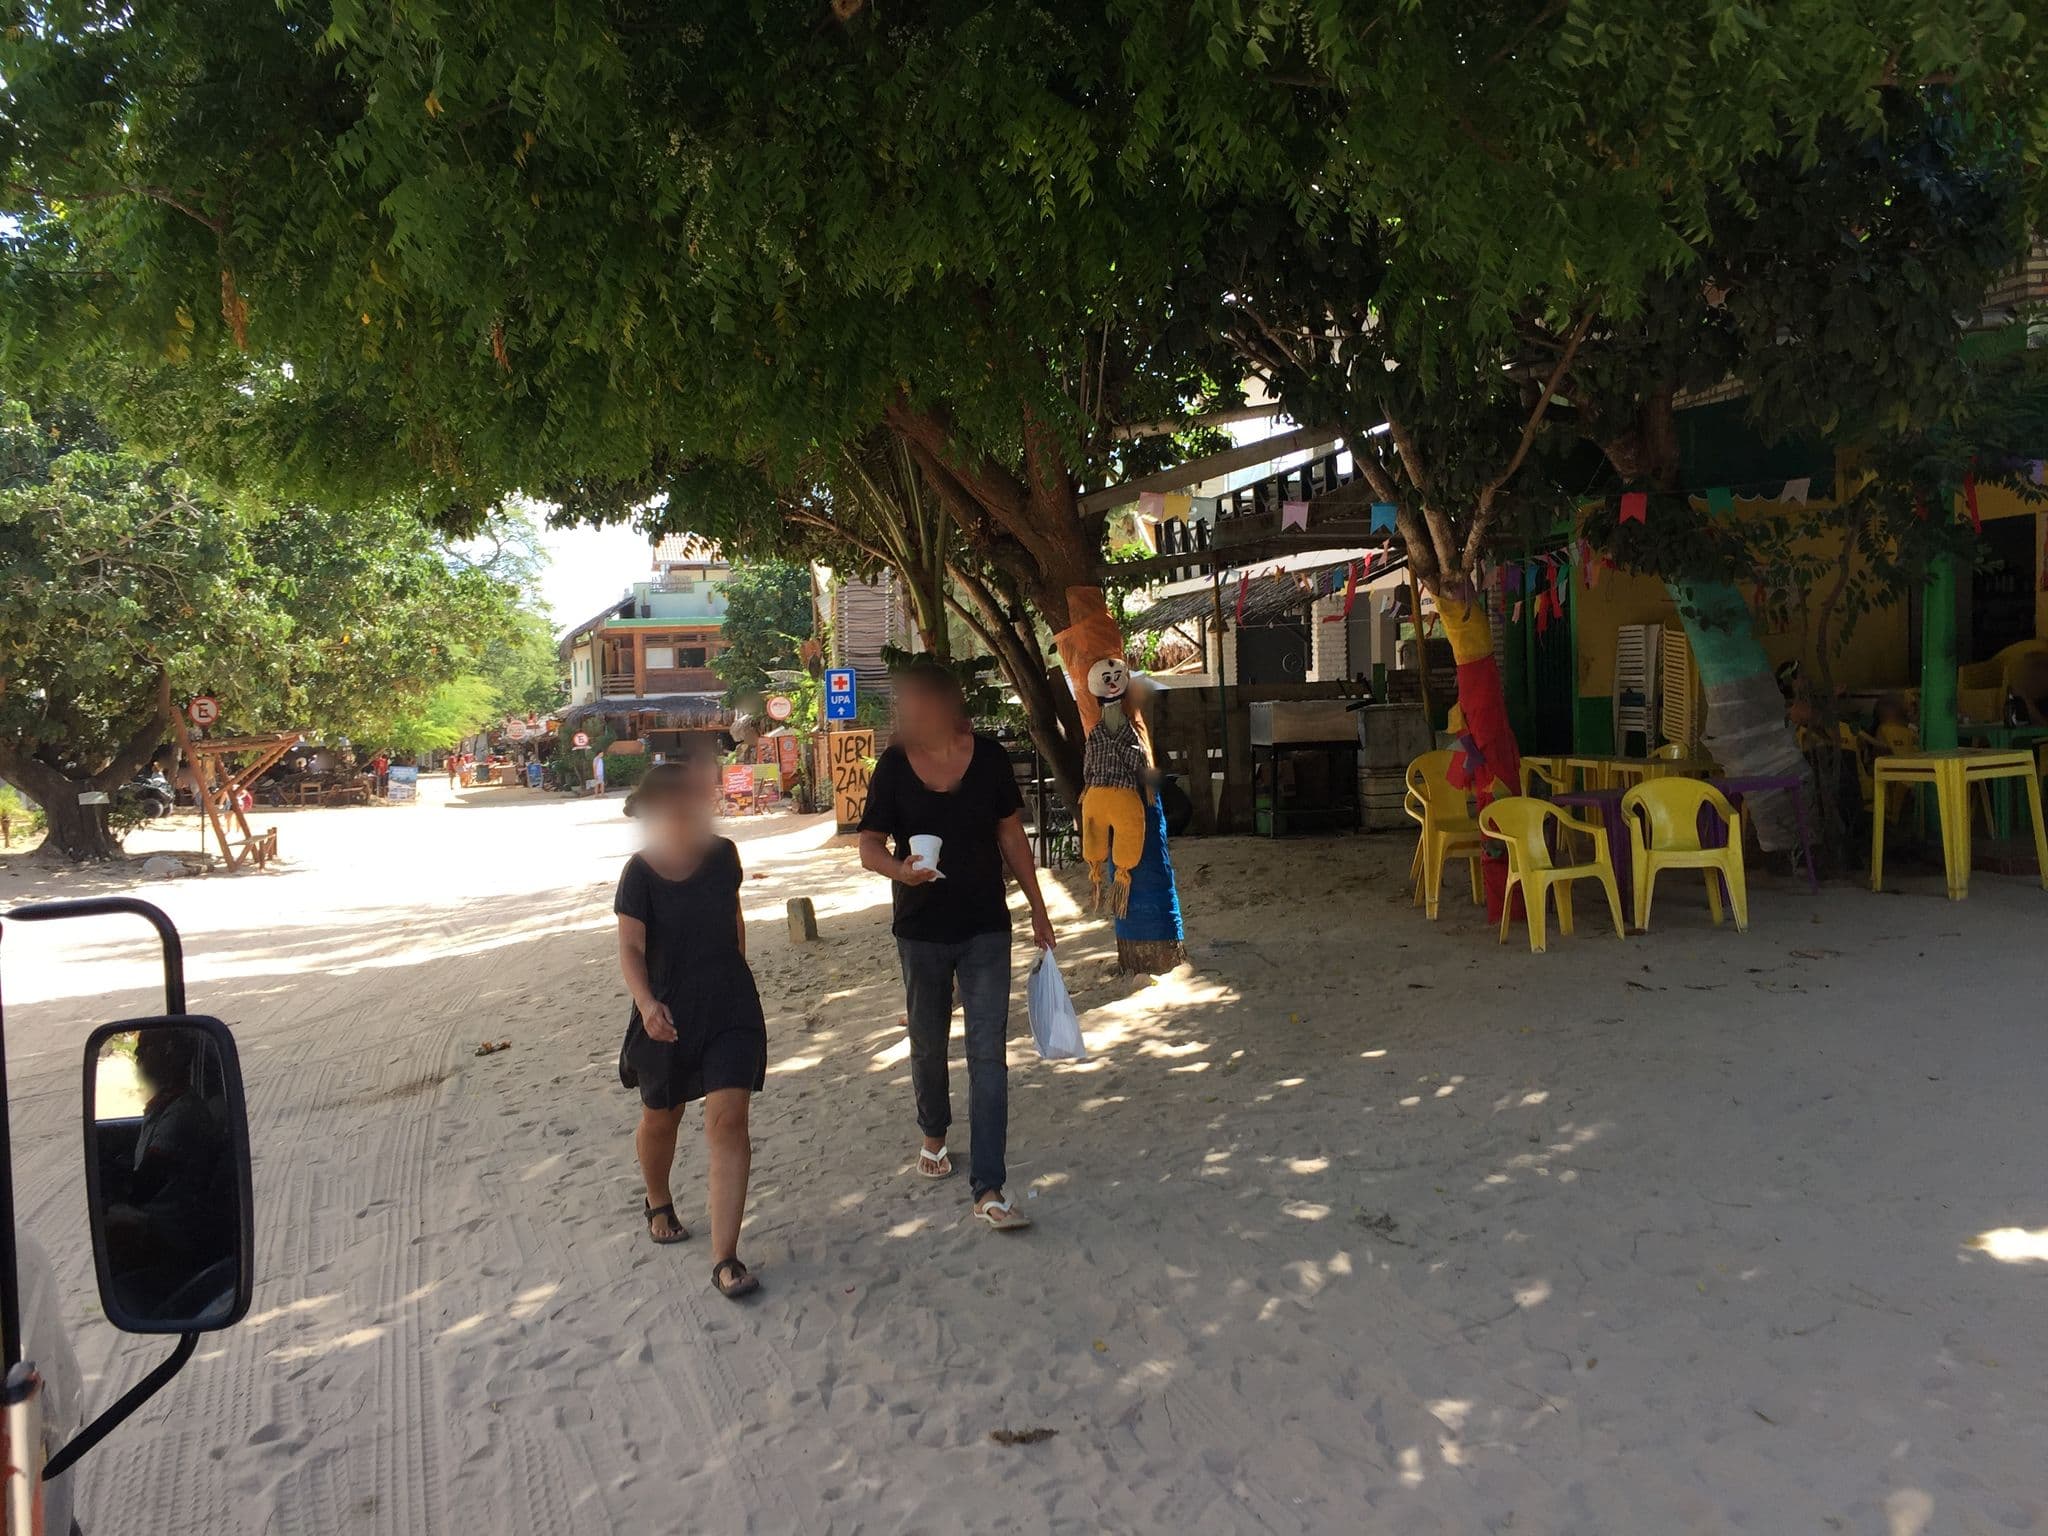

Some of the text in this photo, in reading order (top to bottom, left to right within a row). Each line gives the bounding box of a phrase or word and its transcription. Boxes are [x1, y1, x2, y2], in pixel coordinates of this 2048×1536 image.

[831, 695, 851, 704] UPA
[198, 703, 209, 717] E
[835, 735, 872, 764] JERI
